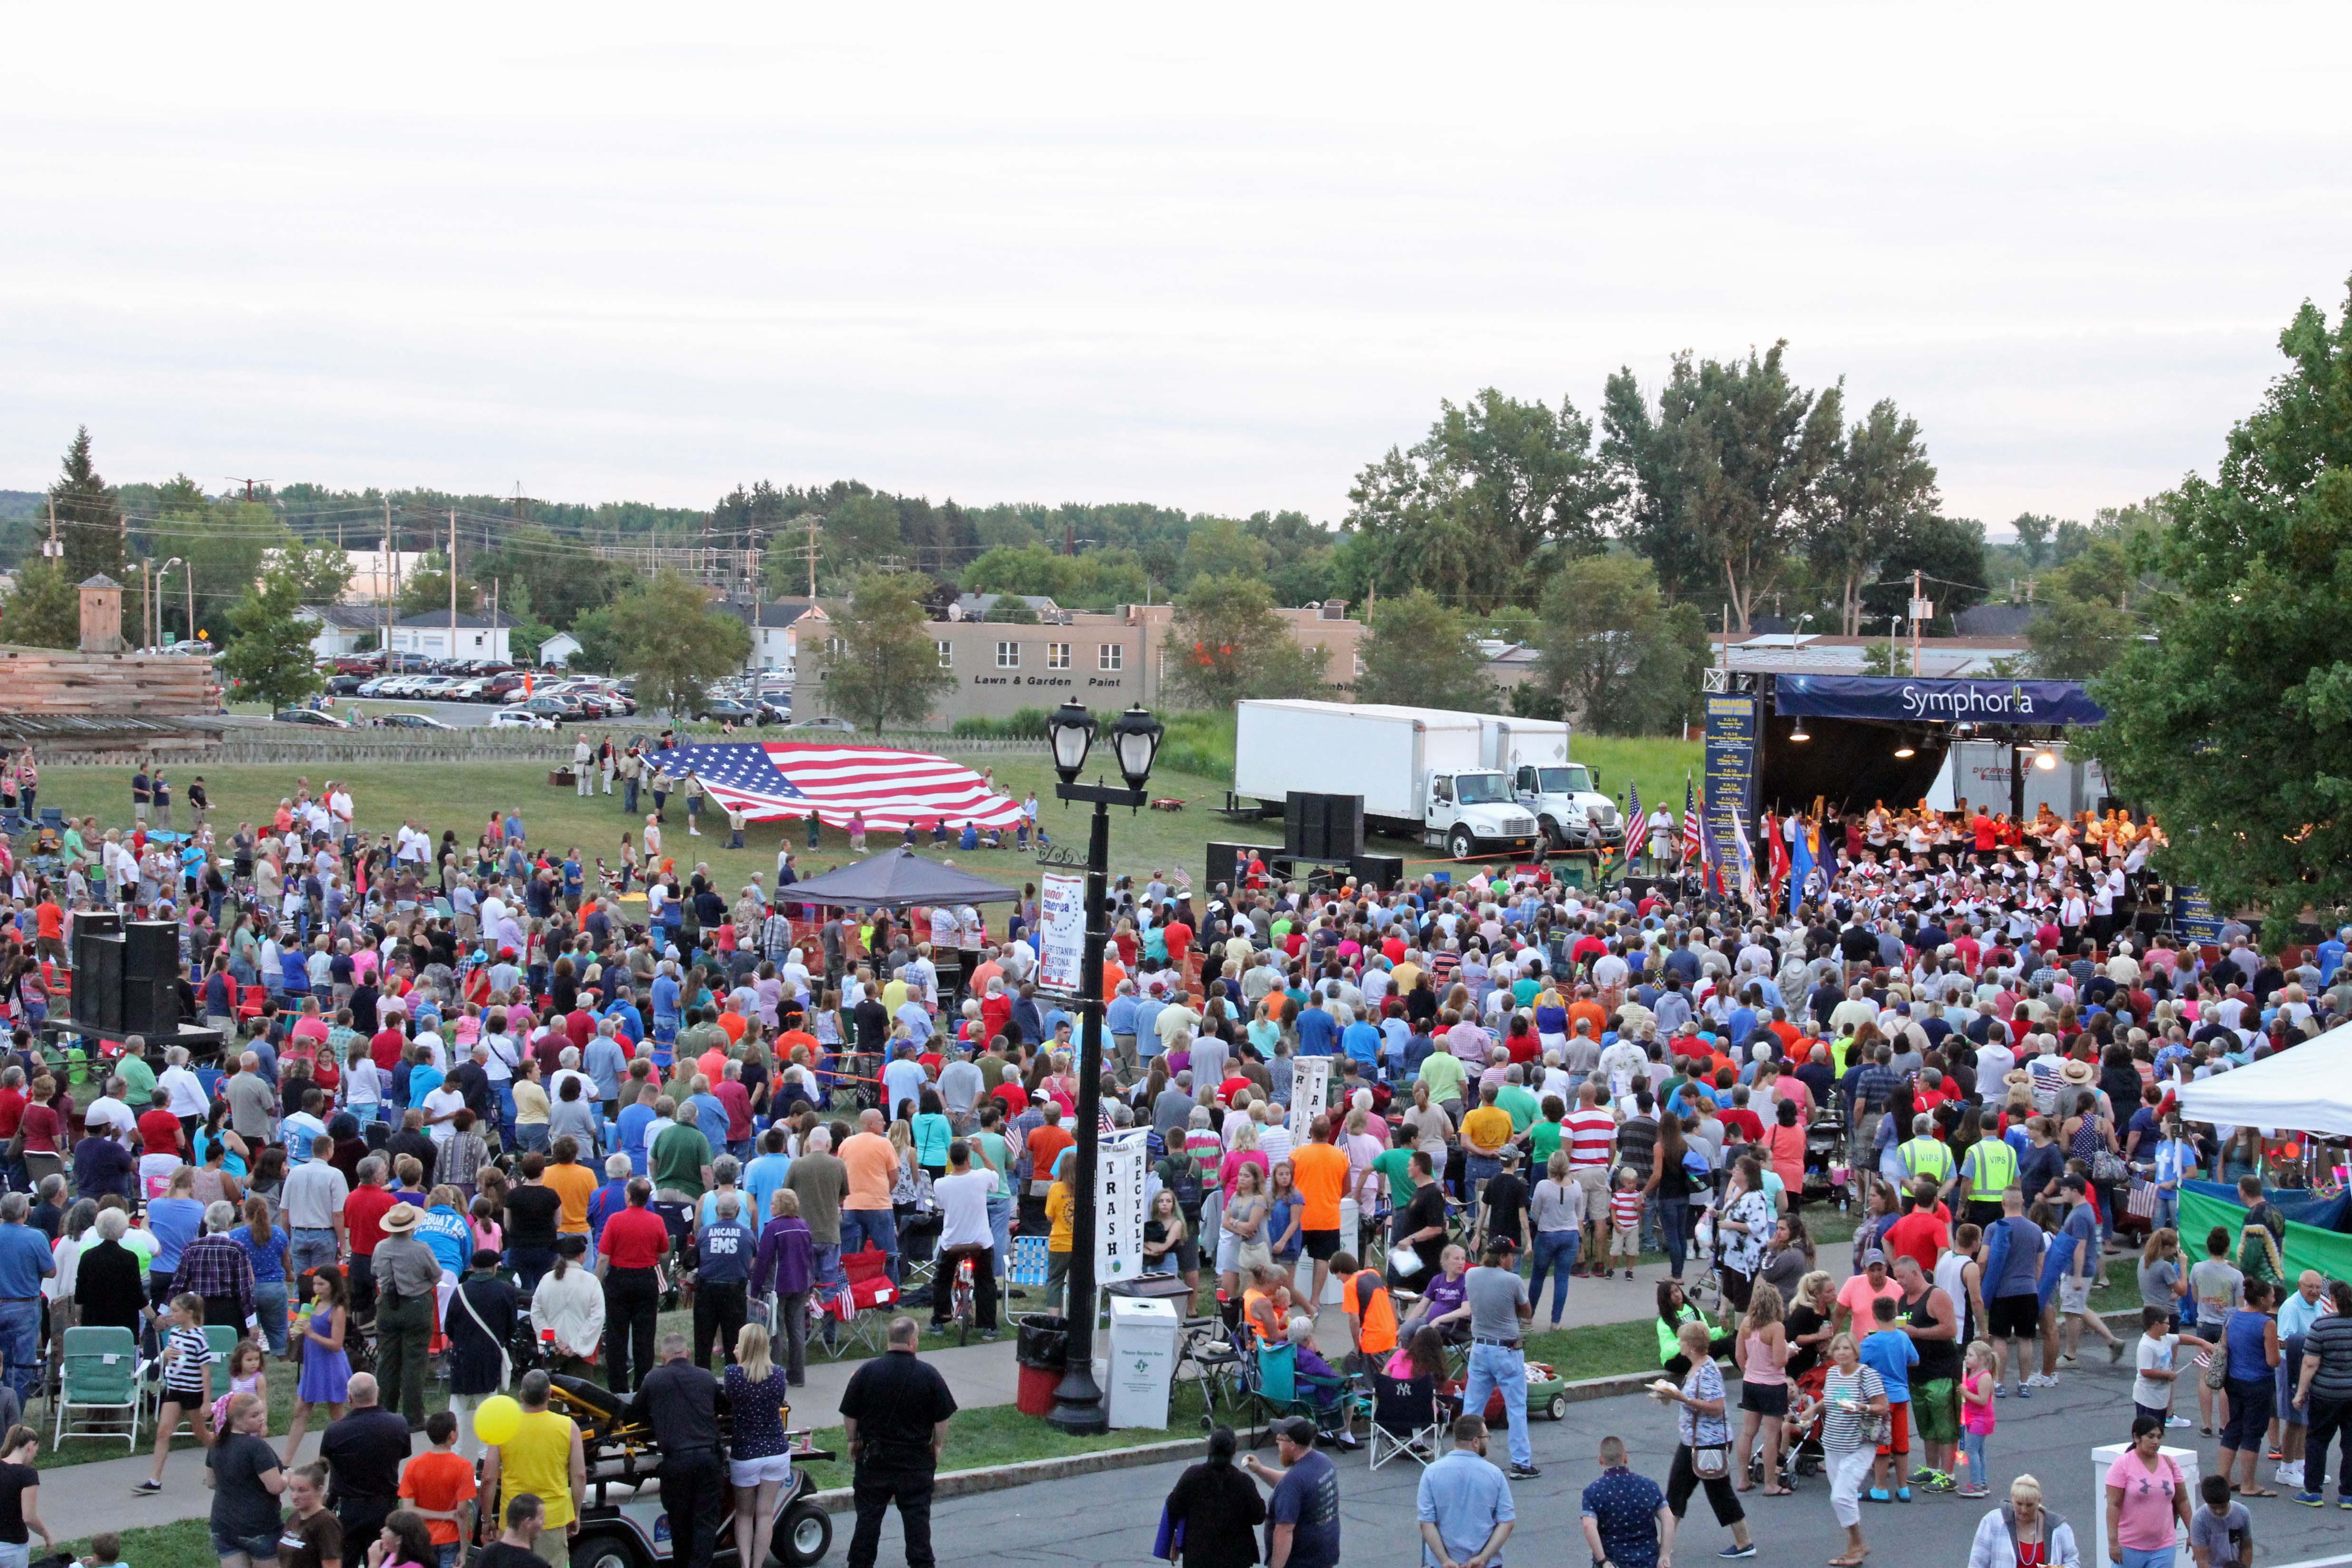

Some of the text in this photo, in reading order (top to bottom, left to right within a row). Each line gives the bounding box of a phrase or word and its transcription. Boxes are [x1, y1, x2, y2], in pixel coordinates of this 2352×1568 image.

[975, 675, 1120, 687] Lawn & Garden Paint
[1903, 685, 2034, 718] Symphoria
[1042, 944, 1055, 954] FORT
[1046, 956, 1071, 967] NATIONAL
[1043, 967, 1072, 979] MONUMENT
[1921, 1154, 1940, 1162] VIPS
[1989, 1156, 2006, 1164] VIPS
[1106, 1161, 1117, 1256] TRASH
[708, 1228, 741, 1237] AMCARE
[710, 1238, 738, 1254] EMS
